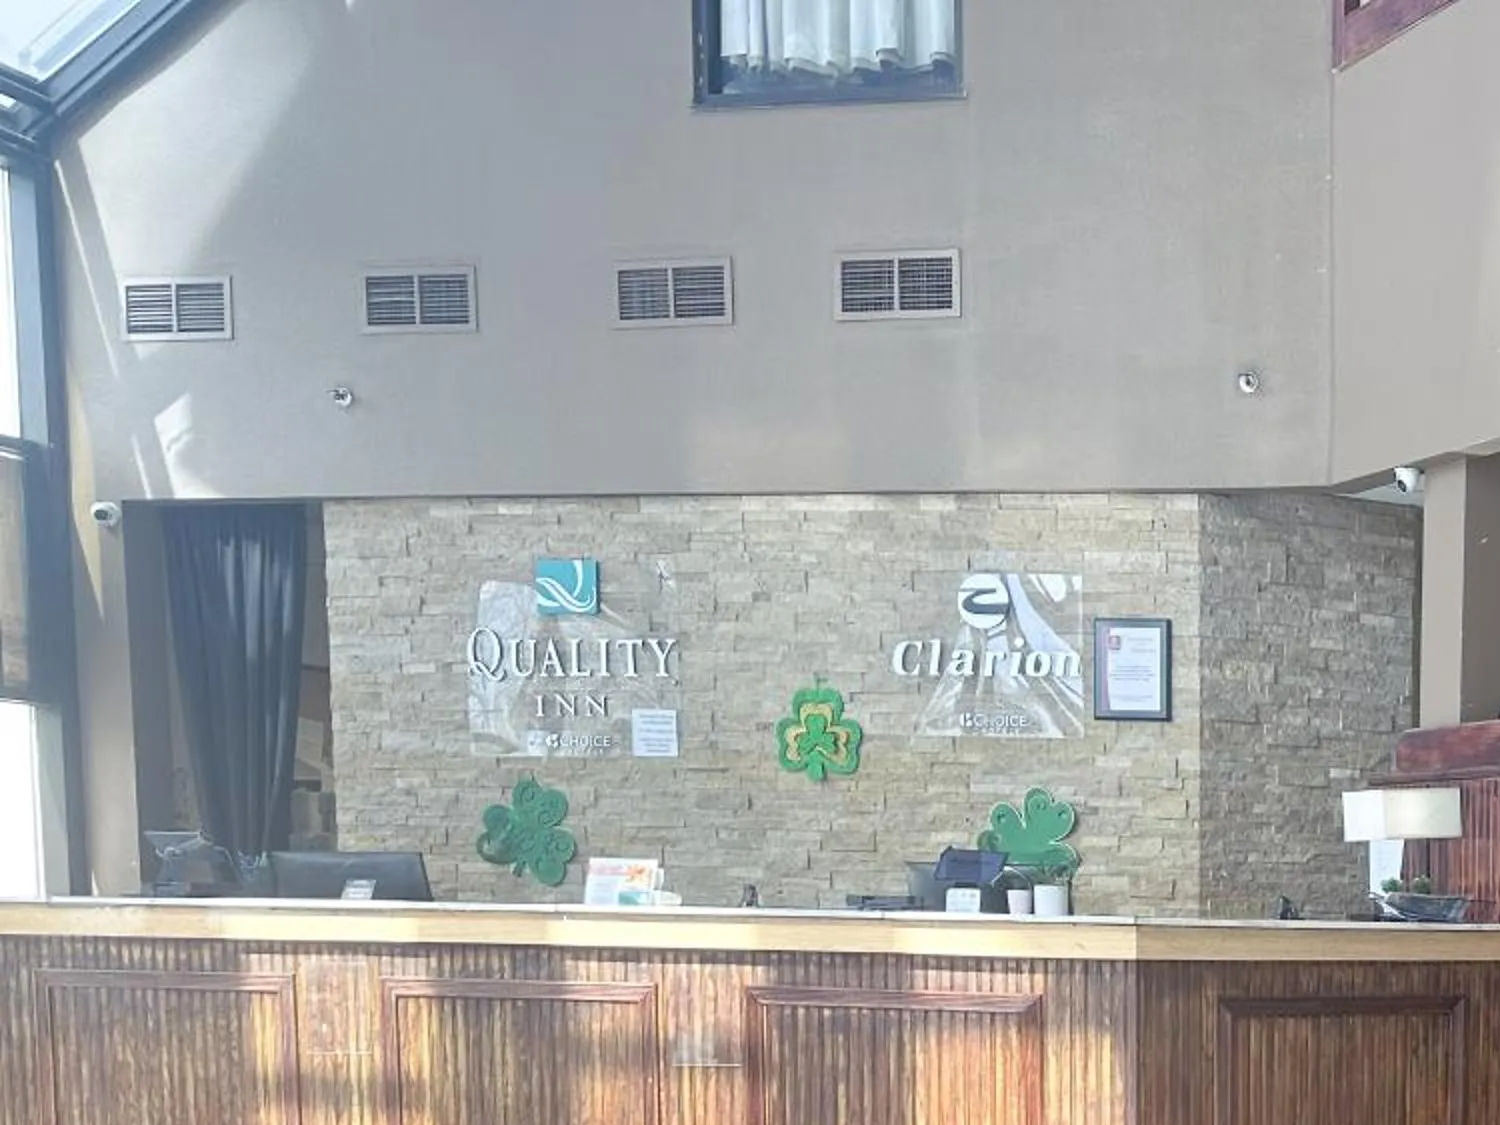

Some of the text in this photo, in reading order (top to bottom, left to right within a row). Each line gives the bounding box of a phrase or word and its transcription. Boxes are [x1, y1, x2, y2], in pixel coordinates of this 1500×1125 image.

[467, 628, 677, 682] QUALITY
[892, 638, 1082, 678] Clarion
[535, 694, 609, 718] INN
[560, 735, 612, 747] CHOICE
